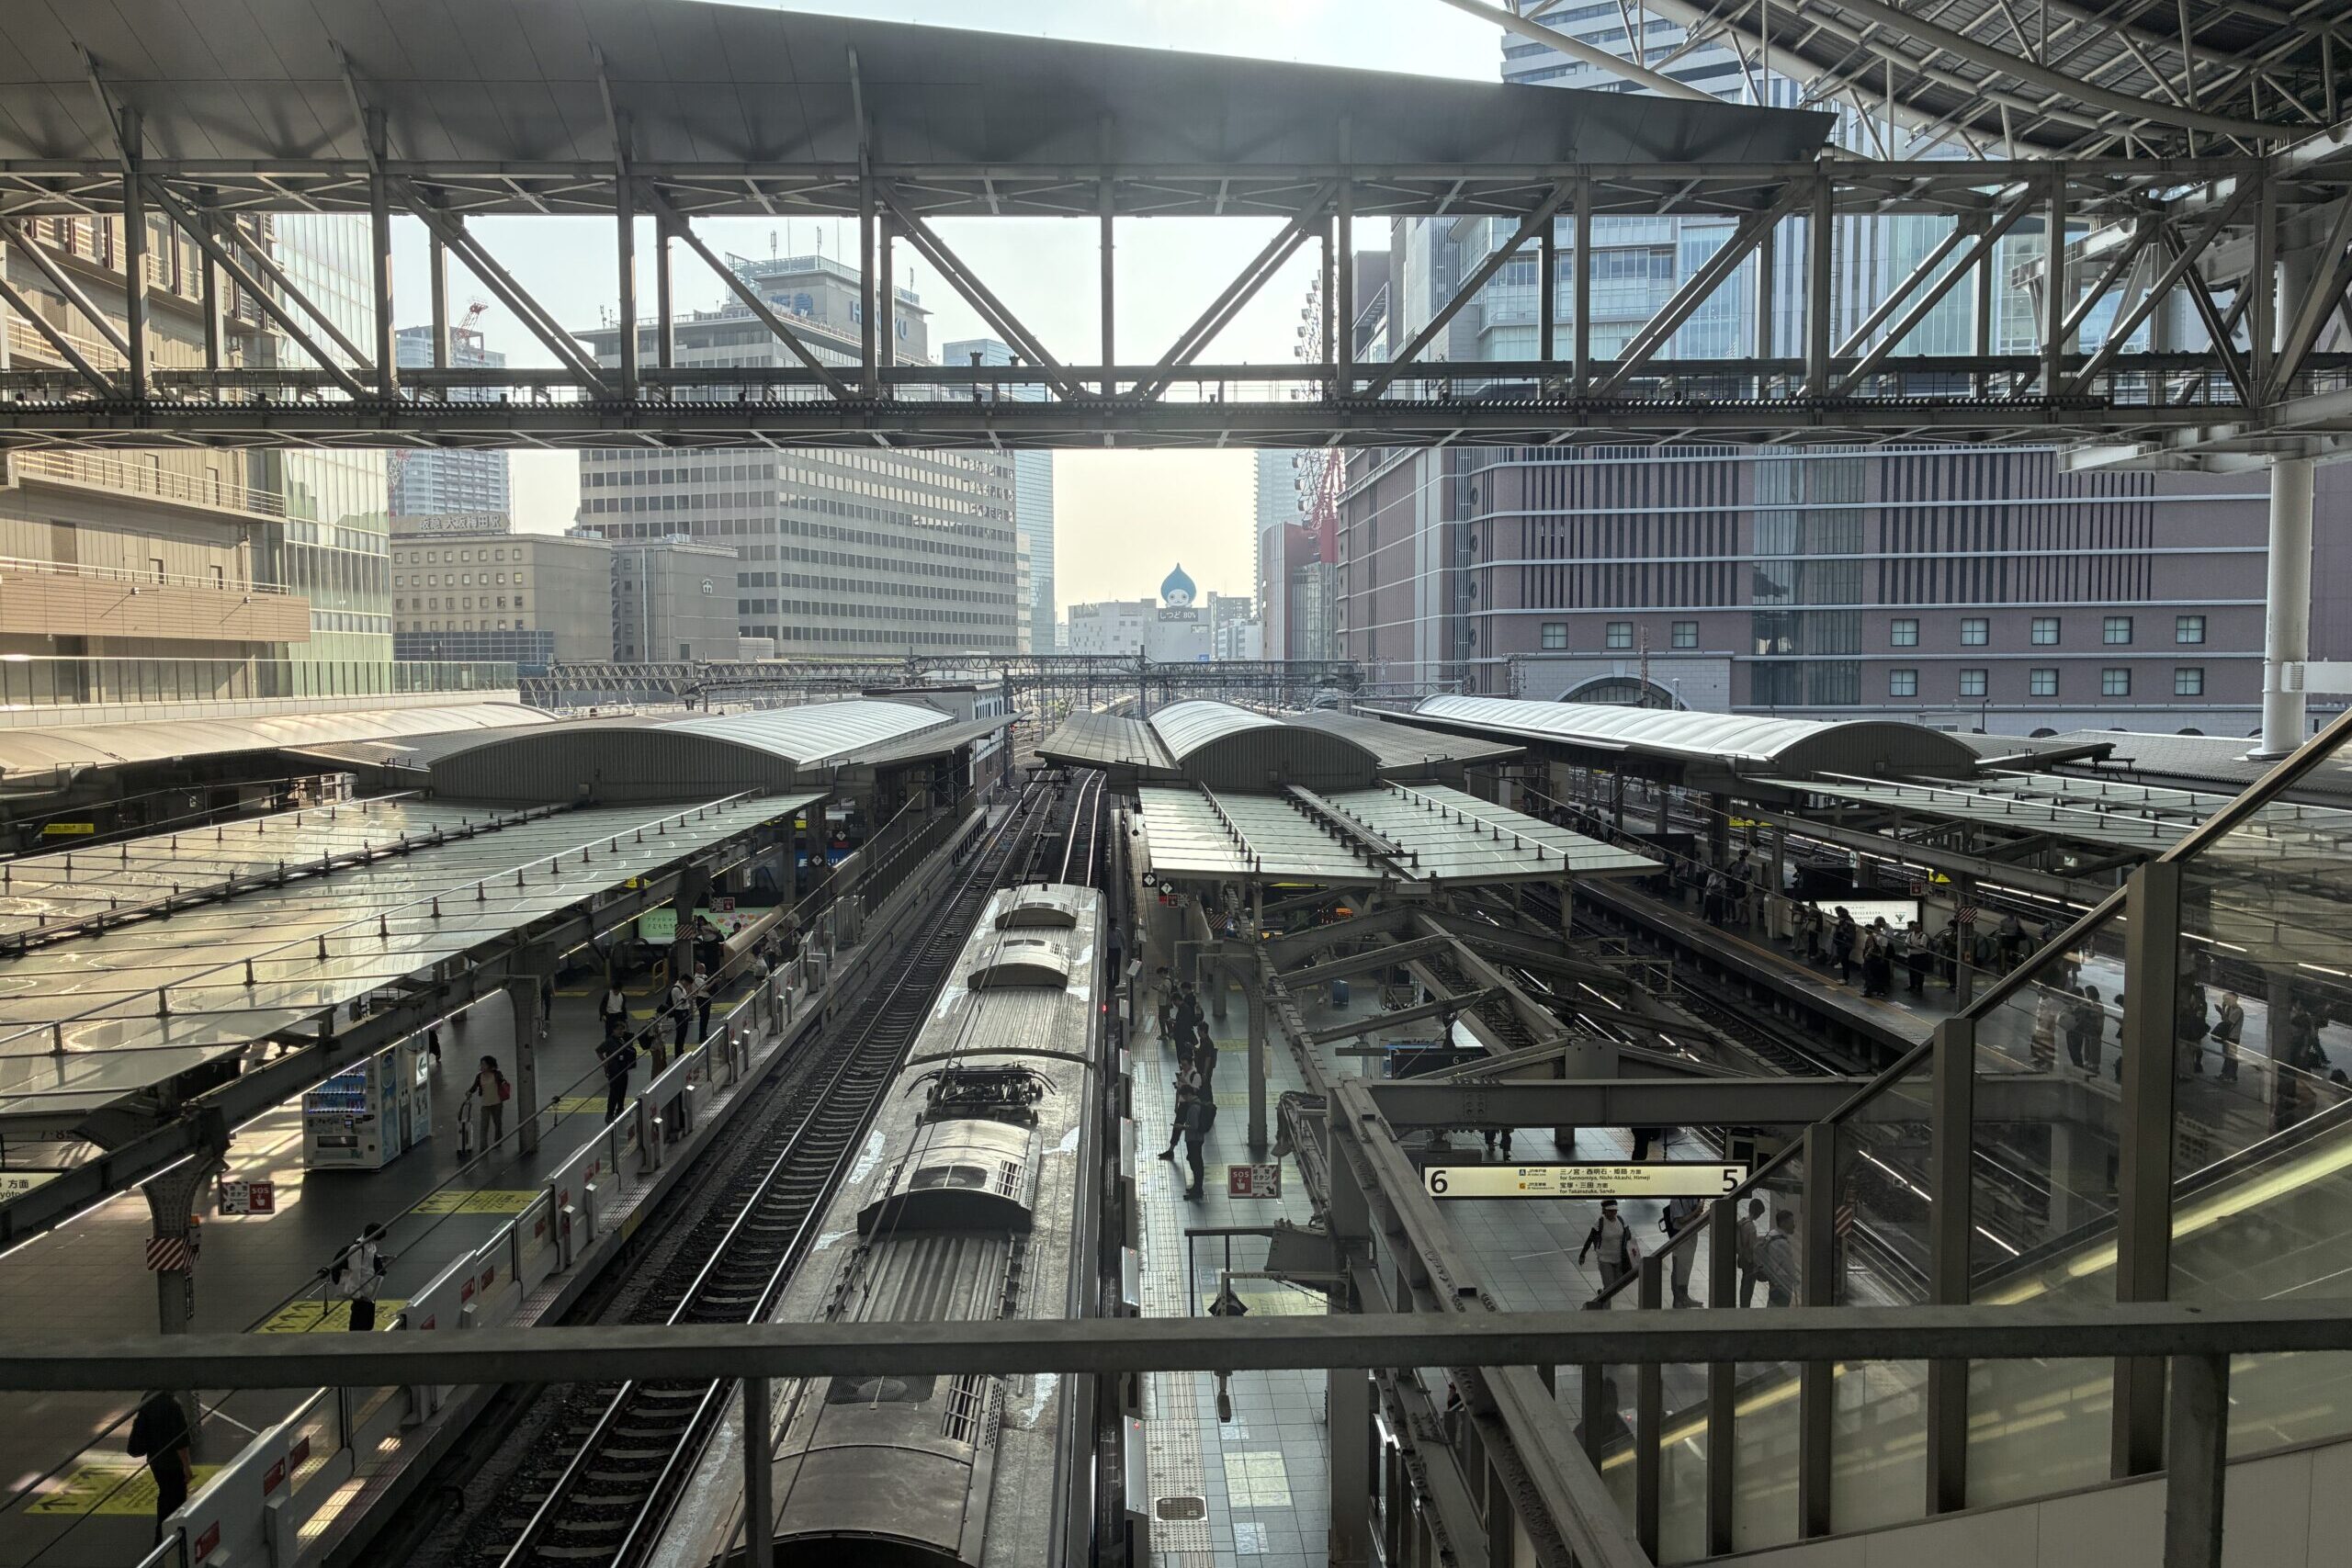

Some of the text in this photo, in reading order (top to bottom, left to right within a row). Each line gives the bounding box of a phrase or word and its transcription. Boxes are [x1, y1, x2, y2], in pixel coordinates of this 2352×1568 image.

[7, 1179, 28, 1189] 方面
[1430, 1169, 1448, 1193] 6
[1723, 1169, 1738, 1191] 5
